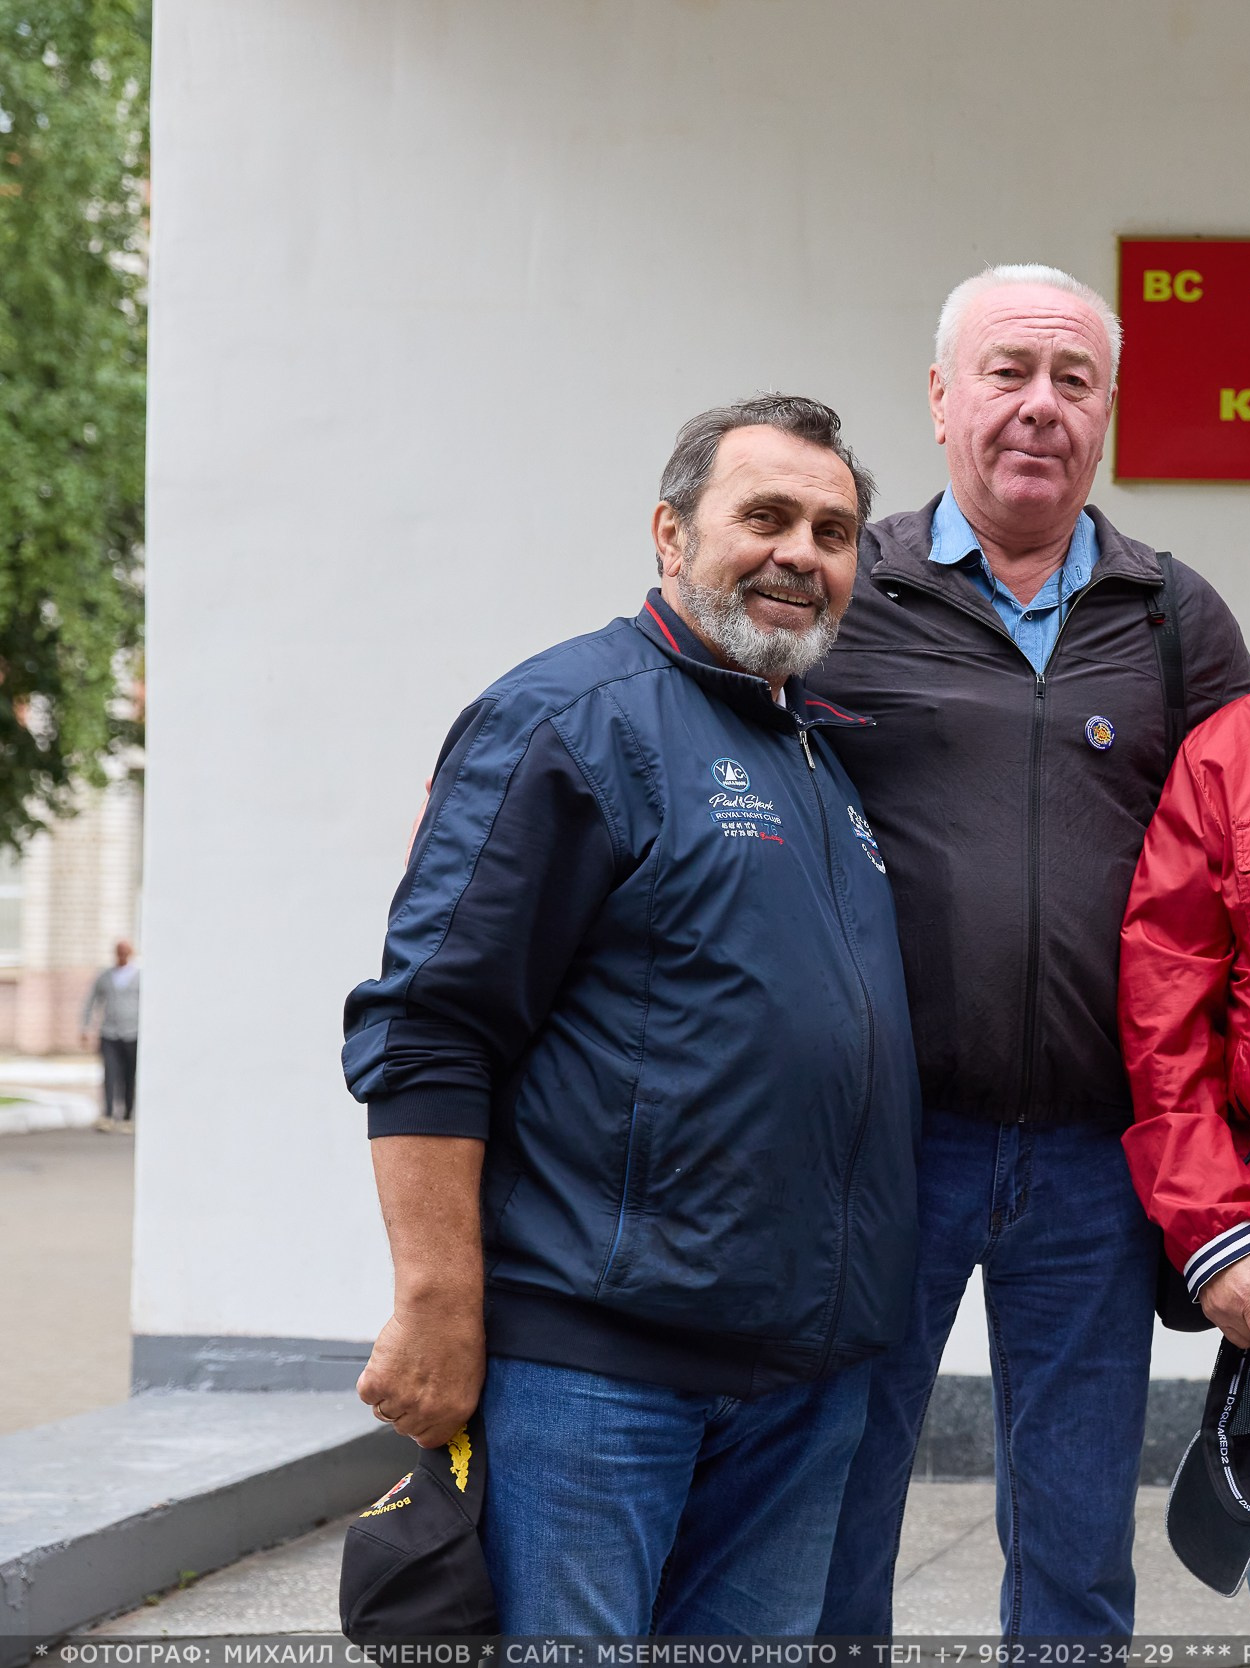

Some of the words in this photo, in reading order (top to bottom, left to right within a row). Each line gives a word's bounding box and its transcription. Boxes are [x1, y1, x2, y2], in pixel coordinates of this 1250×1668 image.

[1143, 270, 1203, 302] ВС
[715, 811, 741, 819] ROYAL
[741, 812, 763, 820] YACHT
[1217, 1396, 1236, 1465] DSQUARED2
